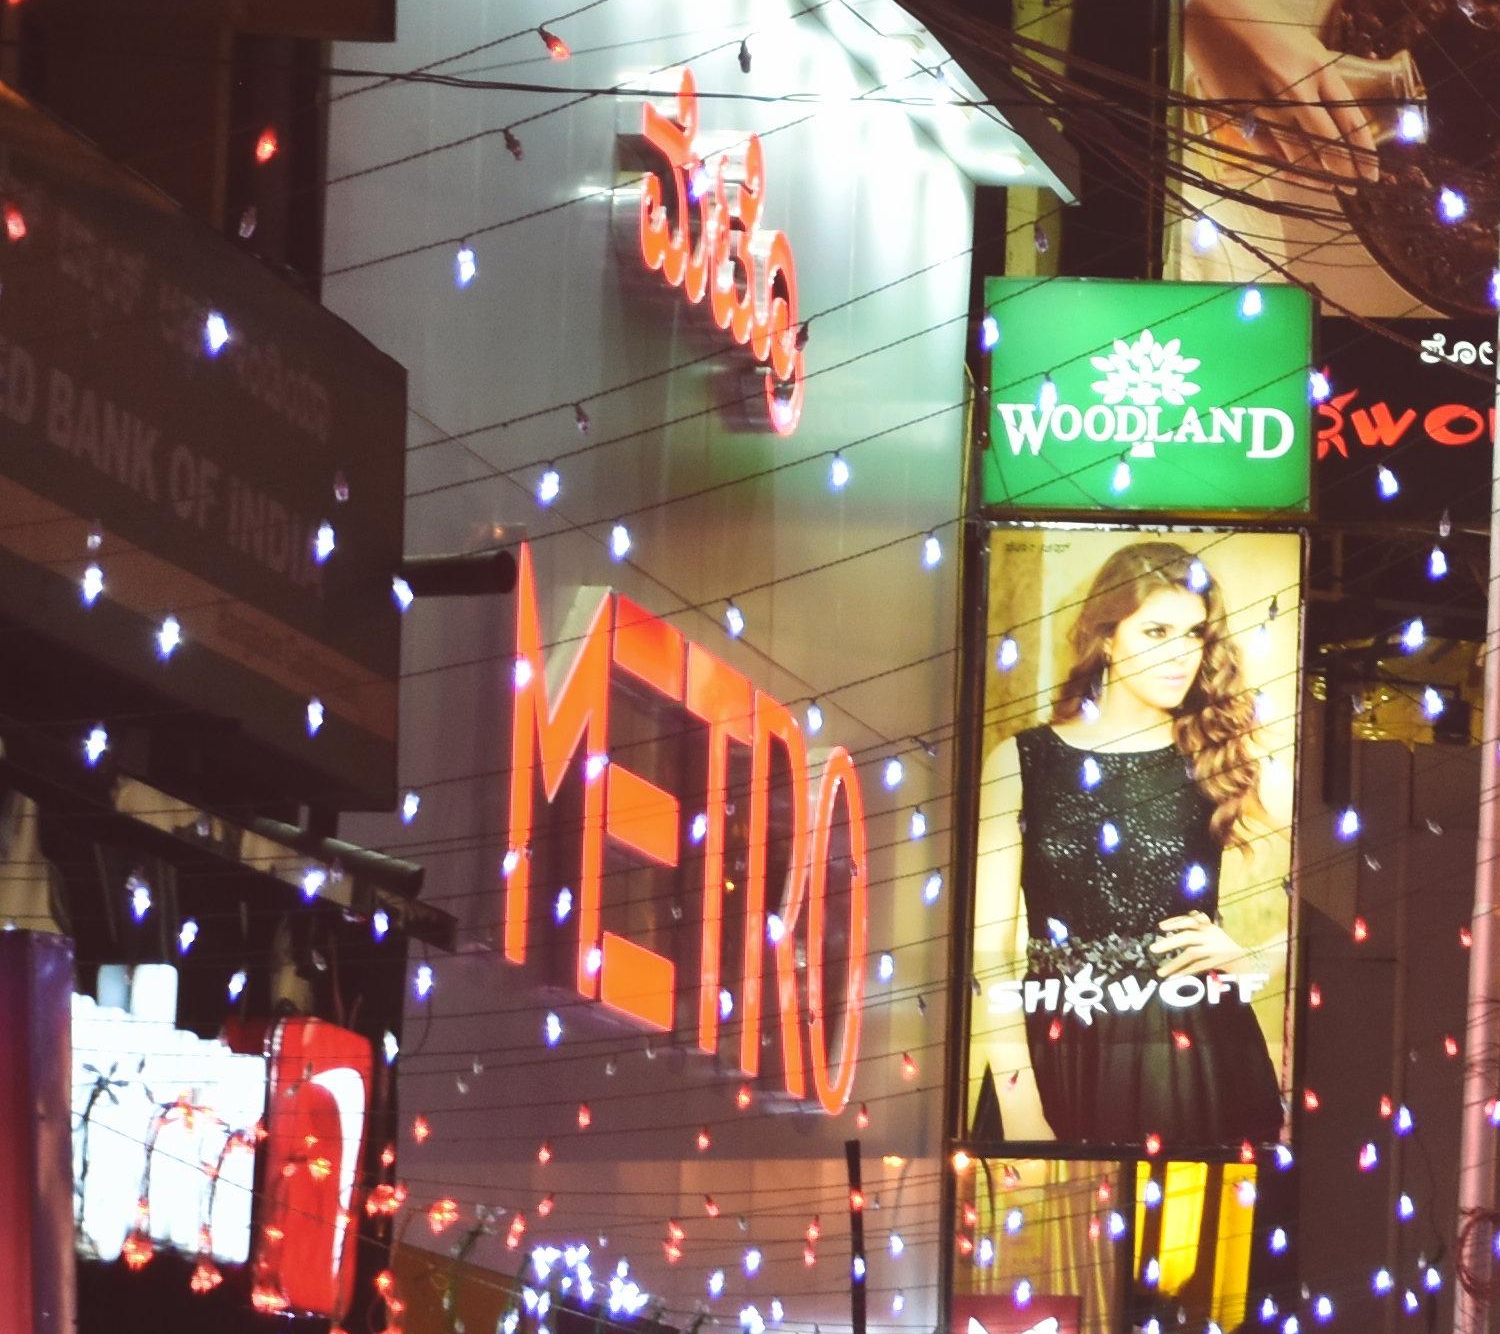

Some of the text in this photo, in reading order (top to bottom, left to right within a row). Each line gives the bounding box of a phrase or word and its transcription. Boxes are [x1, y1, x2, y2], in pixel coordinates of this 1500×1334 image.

[997, 403, 1295, 459] WOODLAND
[503, 540, 867, 1117] METRO
[988, 961, 1269, 1019] SHOWOFF
